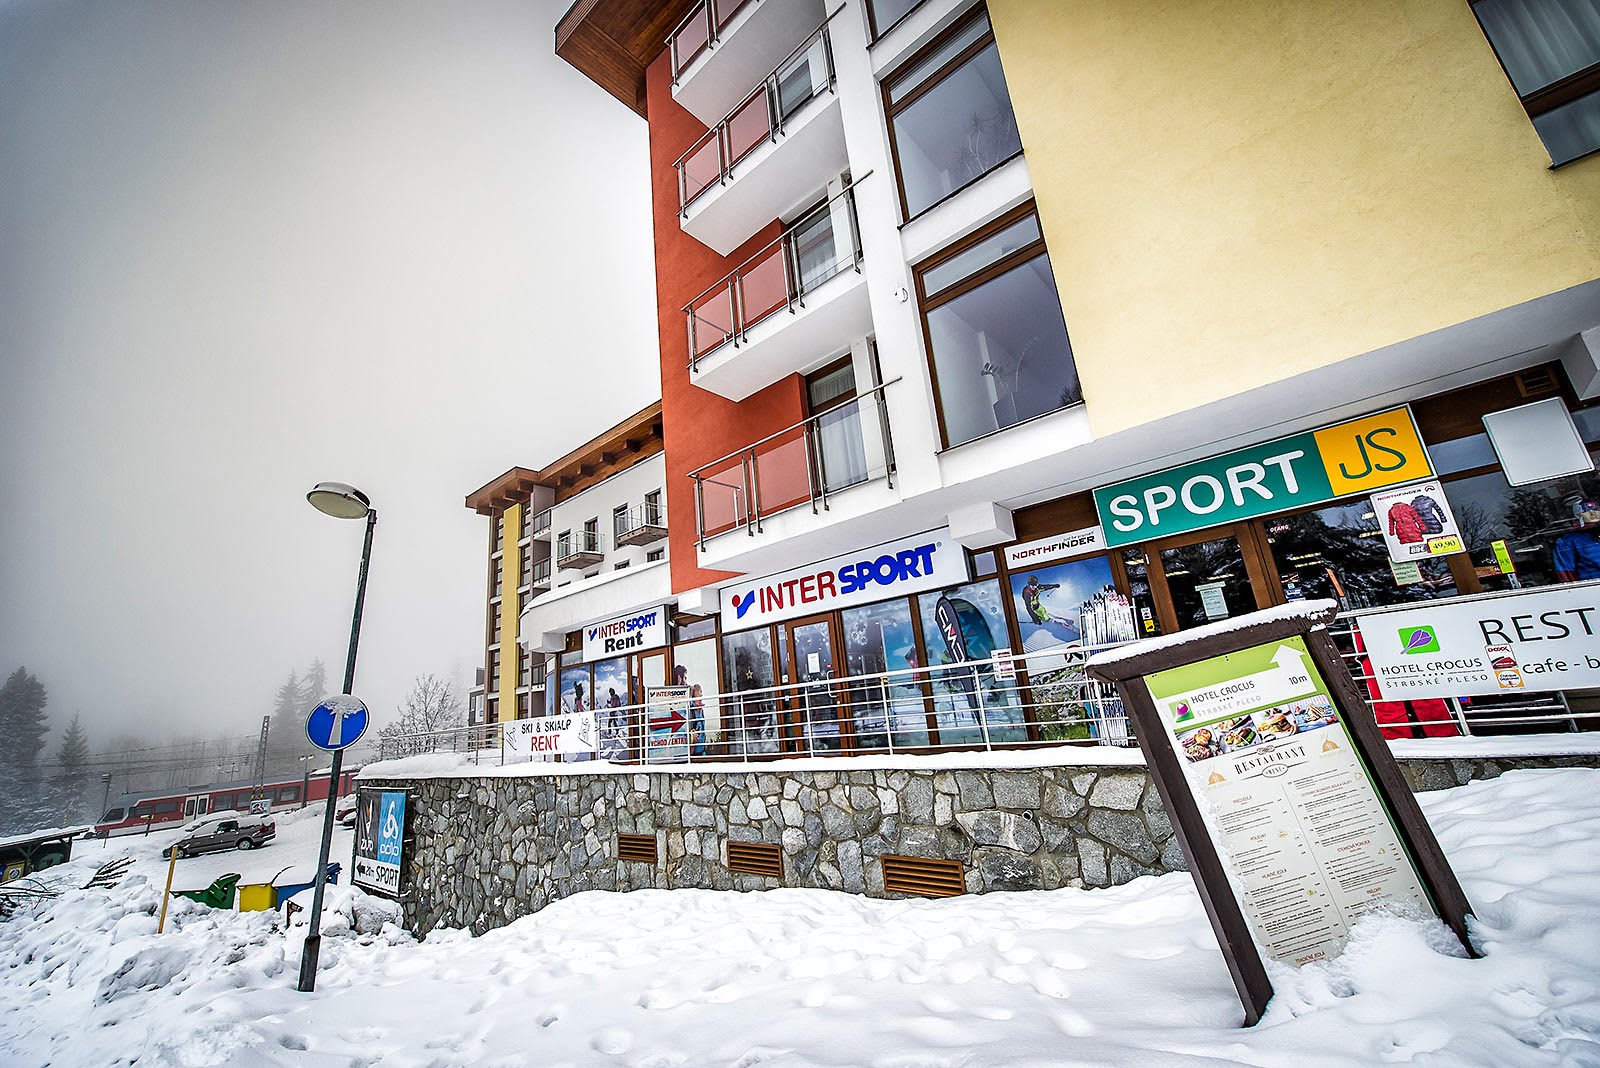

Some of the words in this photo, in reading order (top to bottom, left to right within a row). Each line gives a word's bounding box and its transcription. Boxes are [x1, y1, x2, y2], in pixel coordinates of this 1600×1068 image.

[1109, 450, 1305, 532] SPORT
[1339, 428, 1407, 480] JS
[1377, 488, 1422, 501] NORTHFINDER
[1012, 535, 1096, 560] NORTHFINDER
[598, 612, 657, 640] INTERSPORT
[604, 631, 644, 653] Rent
[1380, 664, 1424, 675] HOTEL
[1426, 657, 1483, 672] CROCUS
[1522, 657, 1568, 675] cafe
[1385, 676, 1441, 689] ŠTRBSKÉ
[1447, 673, 1489, 684] PLESO
[1190, 691, 1219, 704] HOTEL
[1221, 680, 1255, 697] CROCUS
[1236, 695, 1262, 707] PLESO
[521, 722, 533, 735] SKI
[530, 733, 561, 752] RENT
[1234, 745, 1307, 775] RESTAURANT
[376, 865, 399, 887] SPORT
